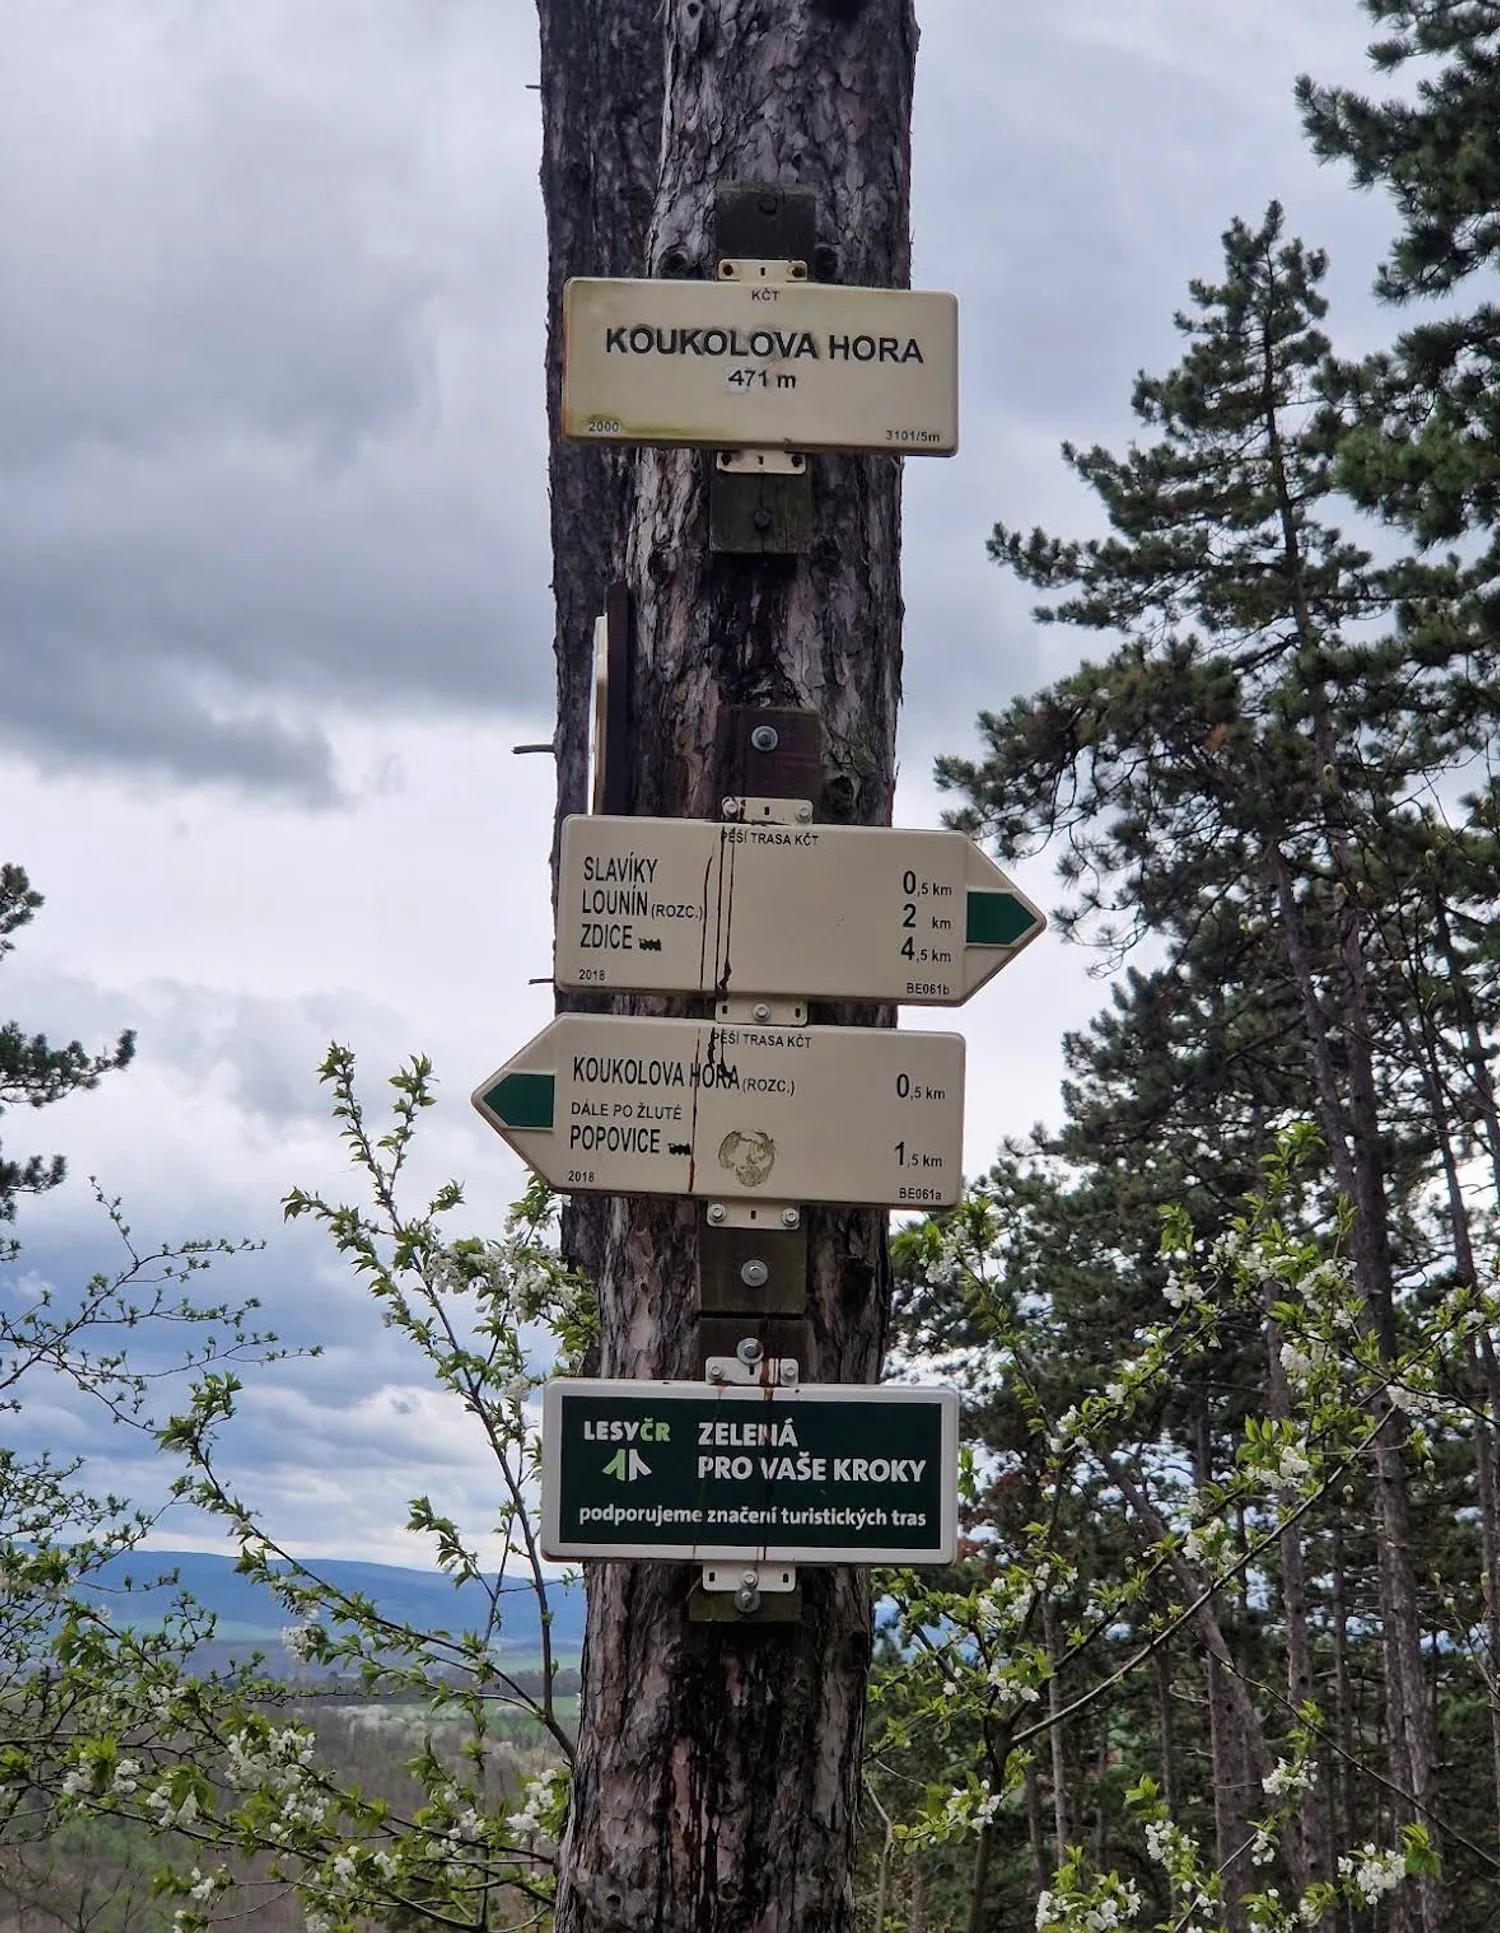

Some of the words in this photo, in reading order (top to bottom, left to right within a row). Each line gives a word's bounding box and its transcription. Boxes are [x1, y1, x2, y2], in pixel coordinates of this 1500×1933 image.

[751, 288, 779, 302] KČT
[605, 327, 818, 360] KOUKOLOVA
[829, 334, 924, 364] HORA
[728, 370, 768, 387] 471
[777, 374, 797, 388] m
[588, 420, 619, 433] 2000
[886, 429, 941, 443] 3101/5m
[751, 831, 791, 845] TRASA
[794, 834, 819, 846] KČT
[583, 851, 658, 883] SLAVÍKY
[903, 870, 929, 897] 0,5
[932, 883, 952, 896] km
[582, 884, 648, 916] LOUNÍN
[651, 903, 703, 922] (ROZC.)
[902, 903, 917, 928] 2
[932, 916, 951, 930] km
[580, 923, 633, 950] ZDICE
[900, 936, 928, 962] 4,5
[931, 949, 951, 962] km
[578, 969, 606, 981] 2018
[906, 982, 950, 996] BE061b
[743, 1033, 784, 1047] TRASA
[787, 1032, 812, 1049] KČT
[573, 1056, 684, 1088] KOUKOLOVA
[689, 1061, 740, 1090] HORA
[742, 1076, 796, 1098] (ROZC.)
[896, 1073, 922, 1100] 0,5
[926, 1087, 946, 1100] km
[571, 1098, 609, 1118] DÁLE
[613, 1104, 633, 1119] PO
[637, 1102, 683, 1121] ŽLUTÉ
[570, 1125, 661, 1154] POPOVICE
[895, 1141, 919, 1168] 1,5
[923, 1155, 943, 1168] km
[568, 1170, 595, 1183] 2018
[899, 1188, 942, 1200] BE061a
[698, 1418, 799, 1448] ZELENÁ
[698, 1456, 753, 1480] PRO
[761, 1451, 827, 1482] VAŠE
[833, 1459, 927, 1483] KROKY
[579, 1504, 702, 1526] podporujeme
[707, 1506, 777, 1525] značení
[781, 1507, 888, 1530] turistických
[892, 1509, 927, 1527] tras
